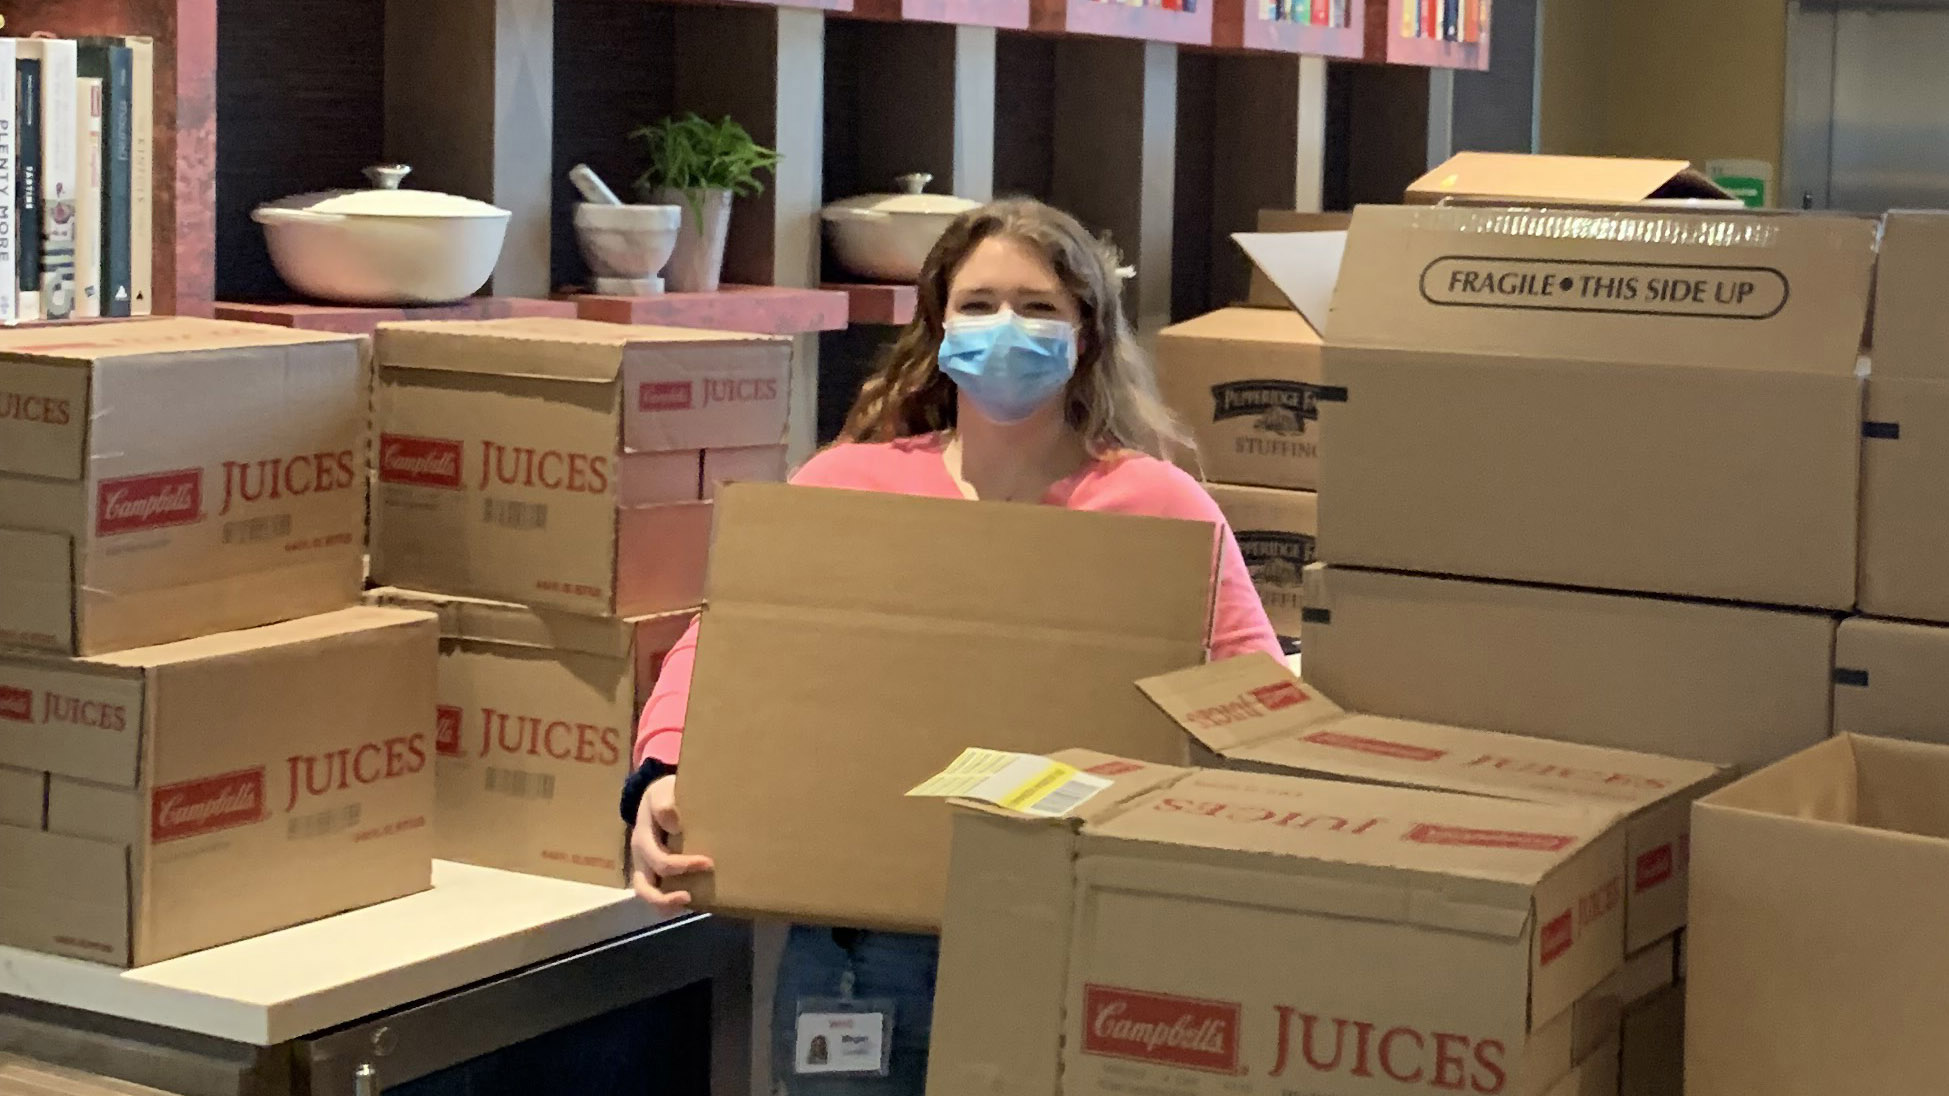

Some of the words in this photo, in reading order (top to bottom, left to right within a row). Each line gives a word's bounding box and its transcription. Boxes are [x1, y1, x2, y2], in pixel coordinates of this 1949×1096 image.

[0, 119, 9, 195] PLENTY
[0, 205, 9, 261] MORE
[1448, 270, 1556, 297] FRAGILE
[1580, 275, 1639, 300] THIS
[1645, 278, 1707, 304] SIDE
[1714, 281, 1755, 305] UP
[0, 391, 70, 426] UICES
[703, 377, 778, 408] JUICES
[218, 450, 355, 516] JUICES
[479, 440, 609, 495] JUICES
[41, 690, 127, 732] JUICES
[479, 707, 621, 766] JUICES
[285, 732, 426, 812] JUICES
[1267, 1004, 1508, 1095] JUICES
